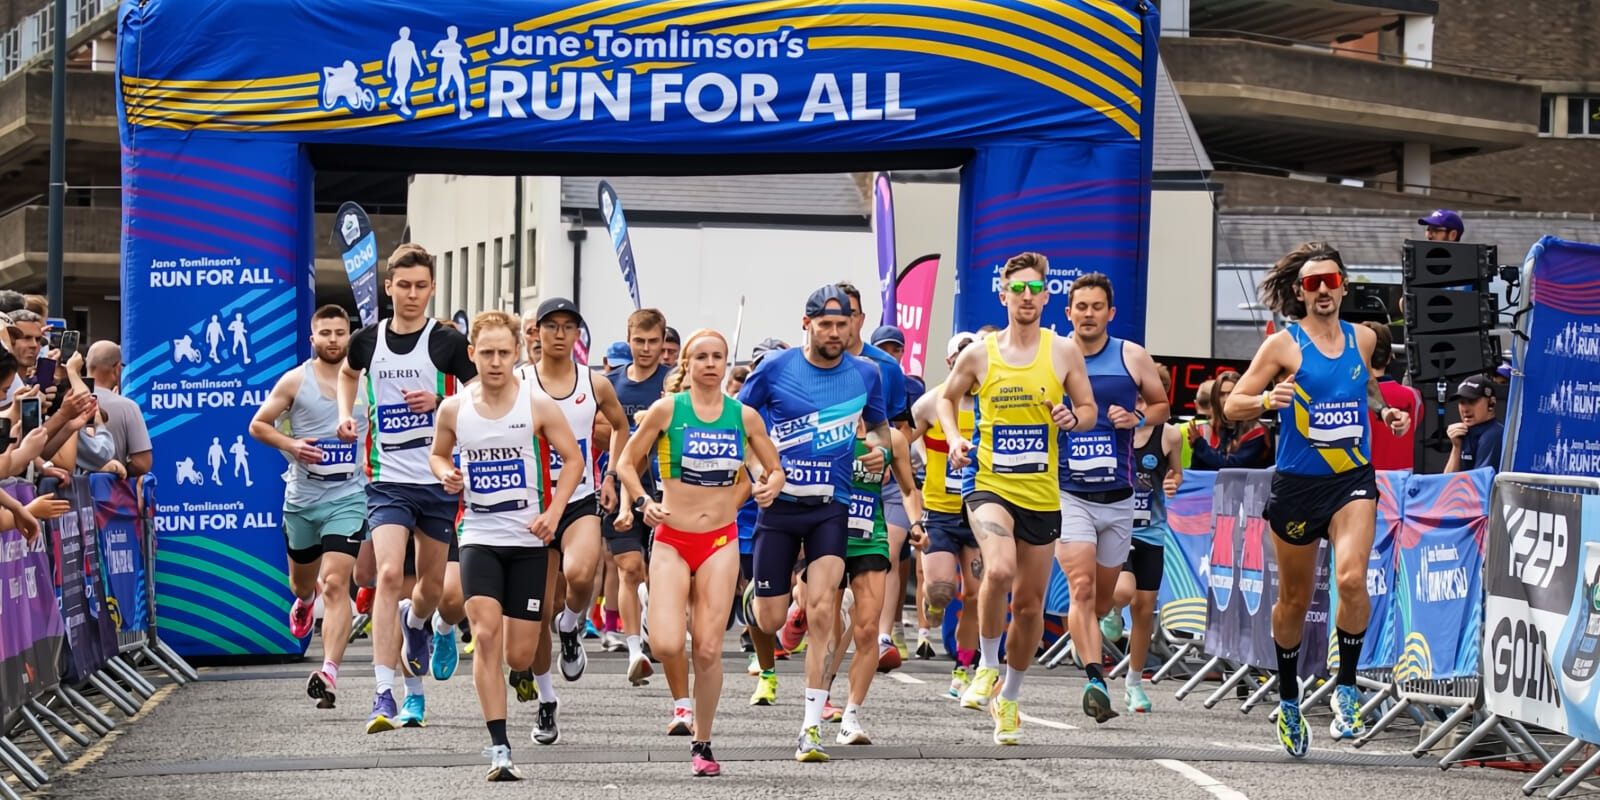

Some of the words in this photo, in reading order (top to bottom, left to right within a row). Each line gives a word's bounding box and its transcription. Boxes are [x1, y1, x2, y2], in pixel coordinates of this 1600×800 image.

[492, 27, 581, 56] Jane
[593, 29, 804, 58] Tomlinson's
[488, 70, 631, 121] RUN
[650, 72, 780, 123] FOR
[798, 72, 916, 121] ALL
[151, 259, 177, 269] Jane
[180, 256, 241, 268] Tomlinson's
[150, 270, 191, 288] RUN
[196, 269, 234, 286] FOR
[239, 268, 273, 285] ALL
[378, 369, 422, 379] DERBY
[152, 381, 177, 391] Jane
[180, 378, 242, 390] Tomlinson's
[151, 392, 192, 410] RUN
[197, 391, 235, 408] FOR
[1573, 395, 1594, 414] RUN
[382, 413, 429, 430] 20322
[1314, 411, 1359, 425] 20031
[818, 422, 854, 447] RUN
[688, 440, 738, 457] 20373
[997, 437, 1045, 450] 20376
[1071, 443, 1113, 456] 20193
[321, 450, 353, 462] 0116
[467, 446, 523, 461] DERBY
[473, 473, 522, 489] 20350
[785, 468, 830, 483] 20111
[183, 501, 245, 512] Tomlinson's
[848, 502, 873, 518] 310
[154, 515, 195, 532] RUN
[200, 513, 238, 530] FOR
[243, 512, 277, 529] ALL
